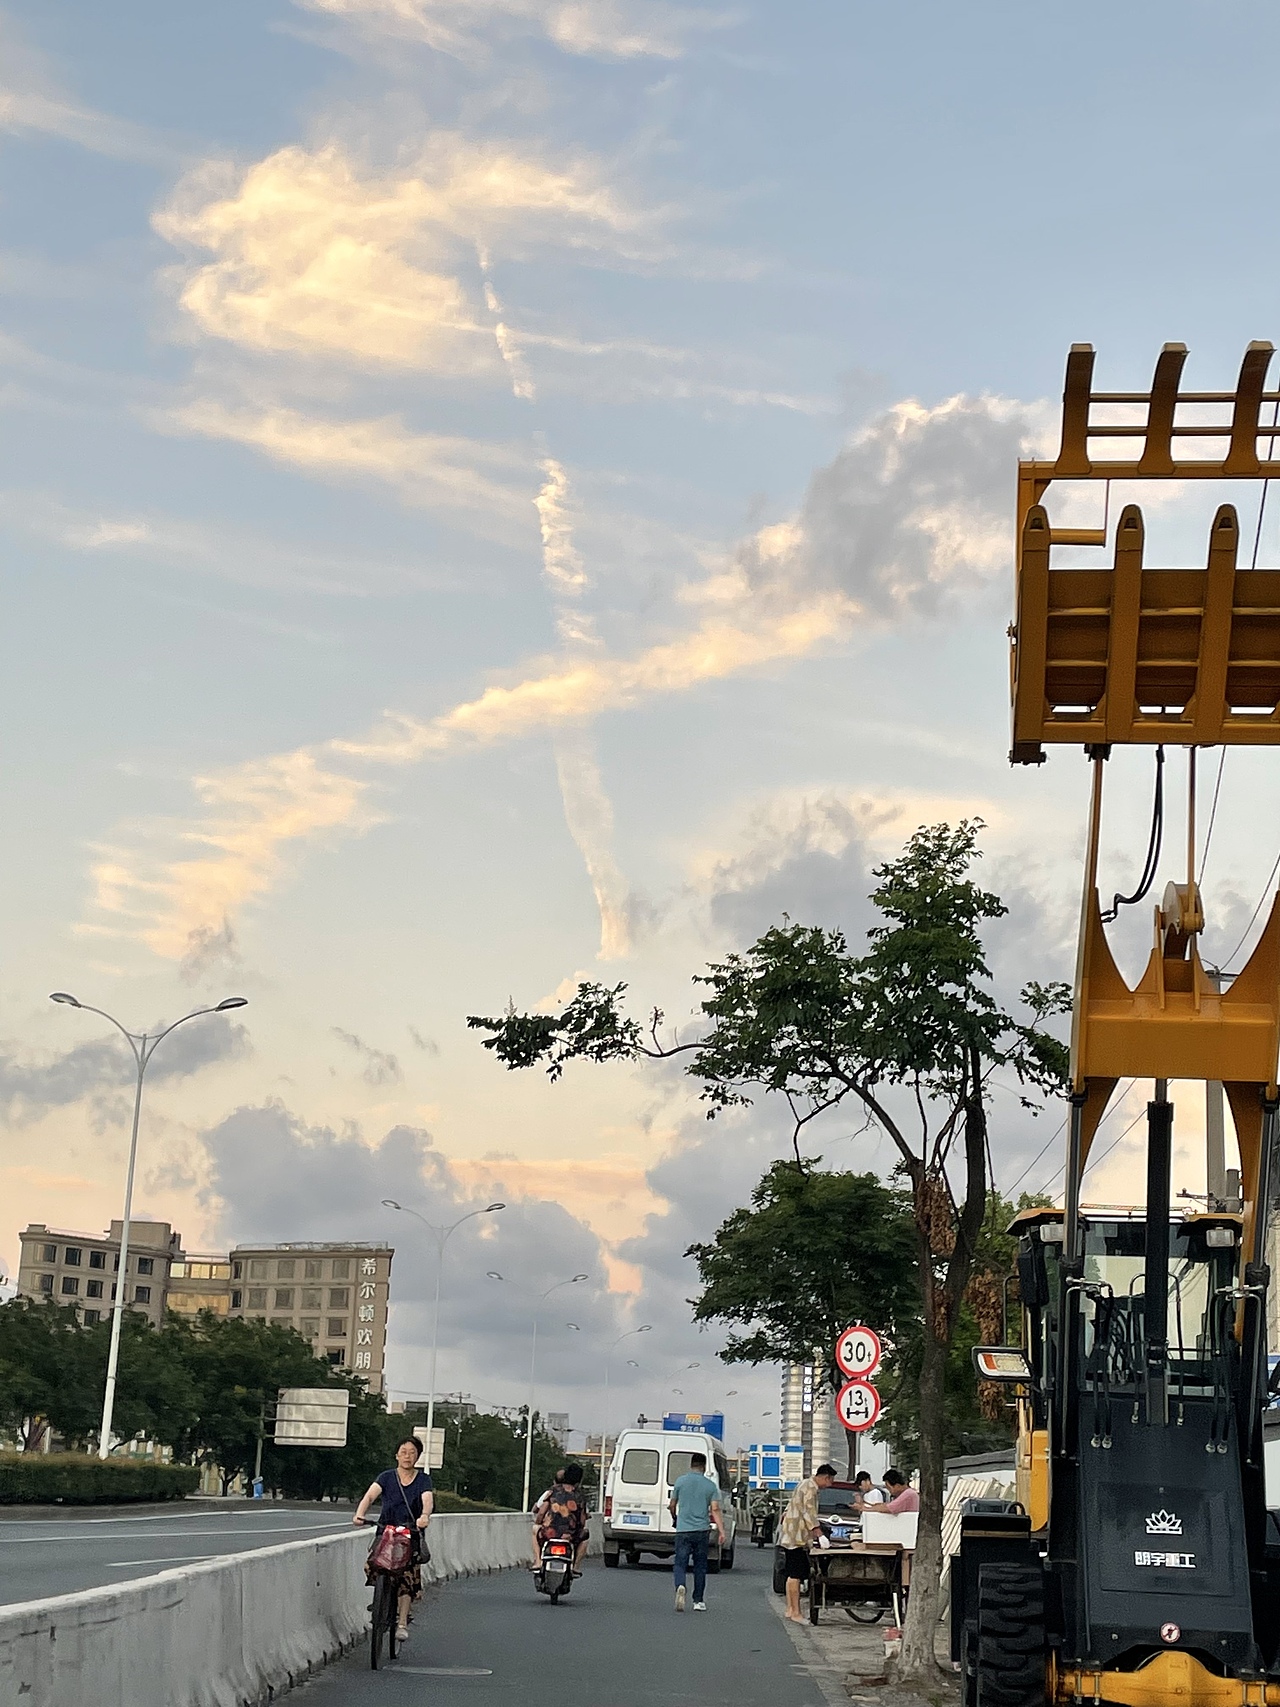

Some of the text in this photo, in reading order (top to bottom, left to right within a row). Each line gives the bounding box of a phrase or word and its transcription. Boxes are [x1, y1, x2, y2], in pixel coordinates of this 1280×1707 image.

[354, 1258, 377, 1392] 希尔顿欢朋
[843, 1341, 872, 1362] 30t
[848, 1390, 868, 1407] 13t
